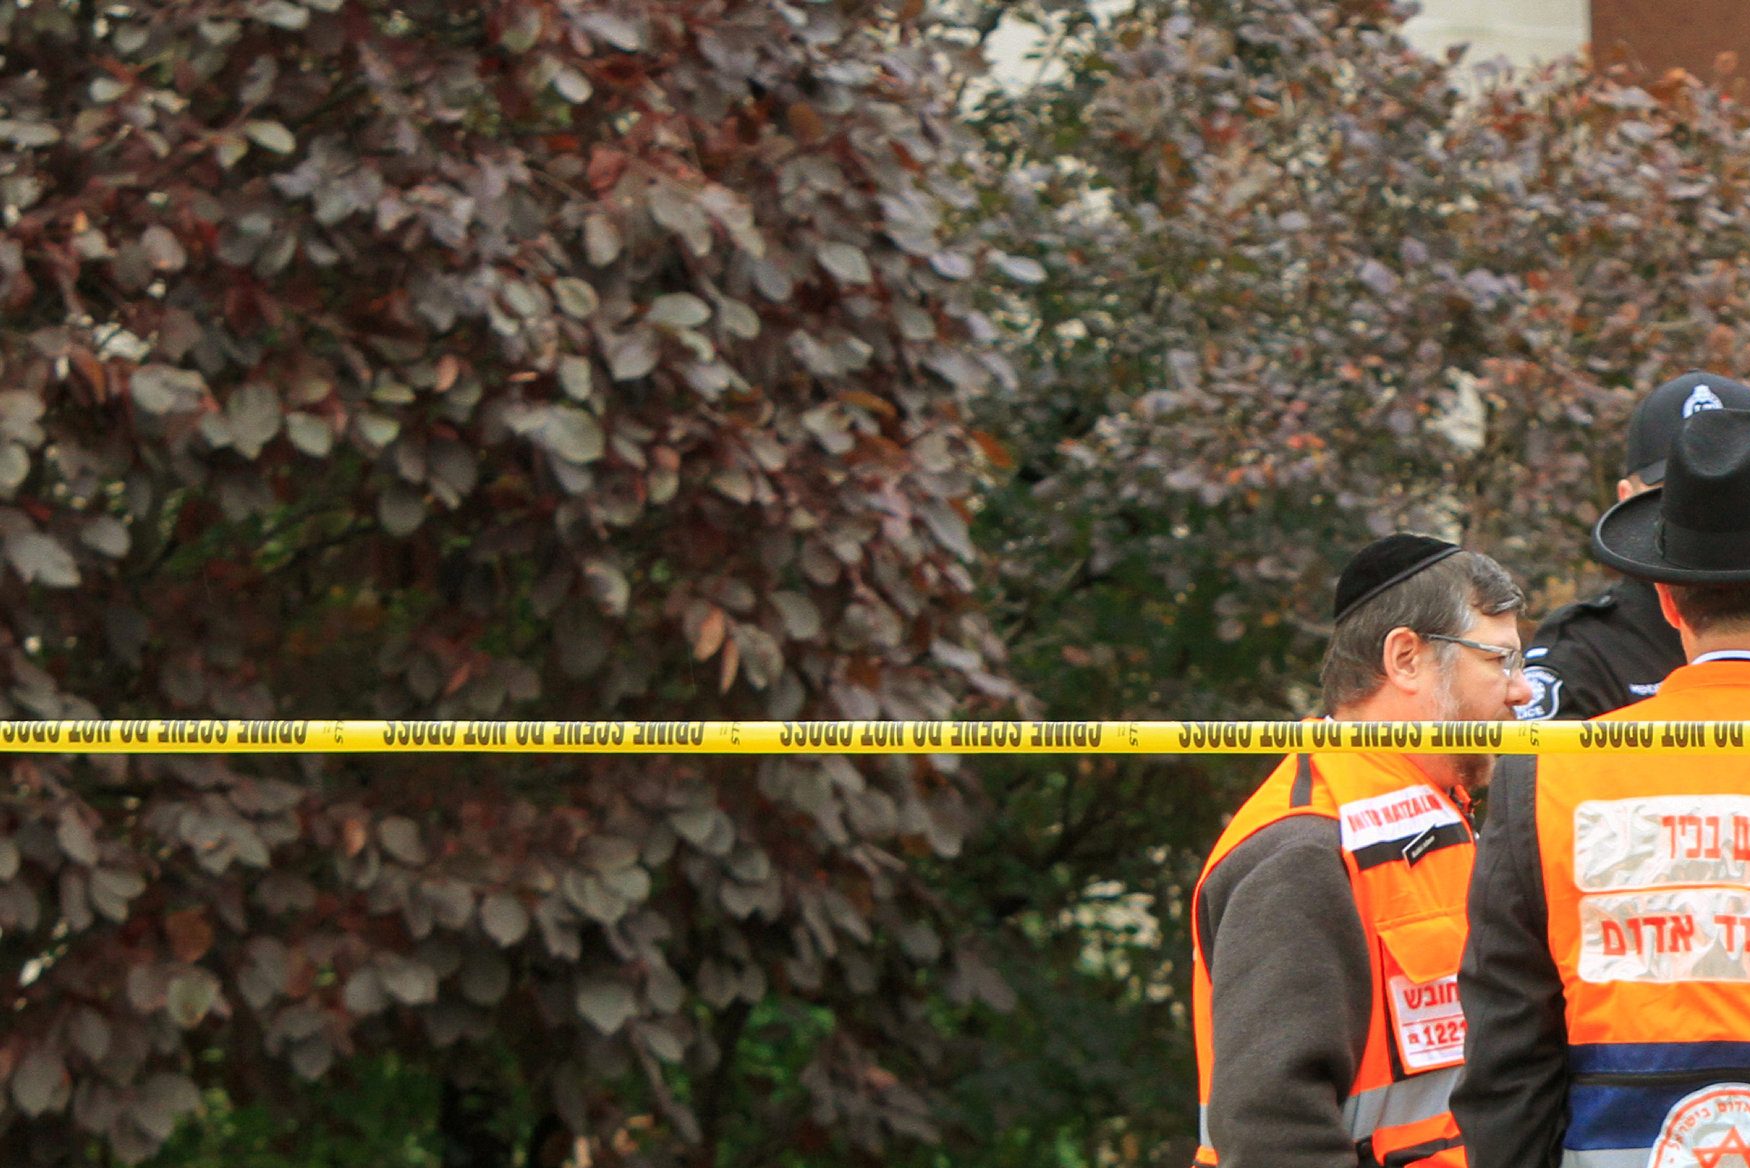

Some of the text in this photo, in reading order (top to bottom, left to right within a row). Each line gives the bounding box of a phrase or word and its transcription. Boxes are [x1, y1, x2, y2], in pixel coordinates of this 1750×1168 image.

[1661, 815, 1722, 860] בכיר
[1602, 914, 1694, 956] אדום
[1403, 981, 1461, 1010] חובש
